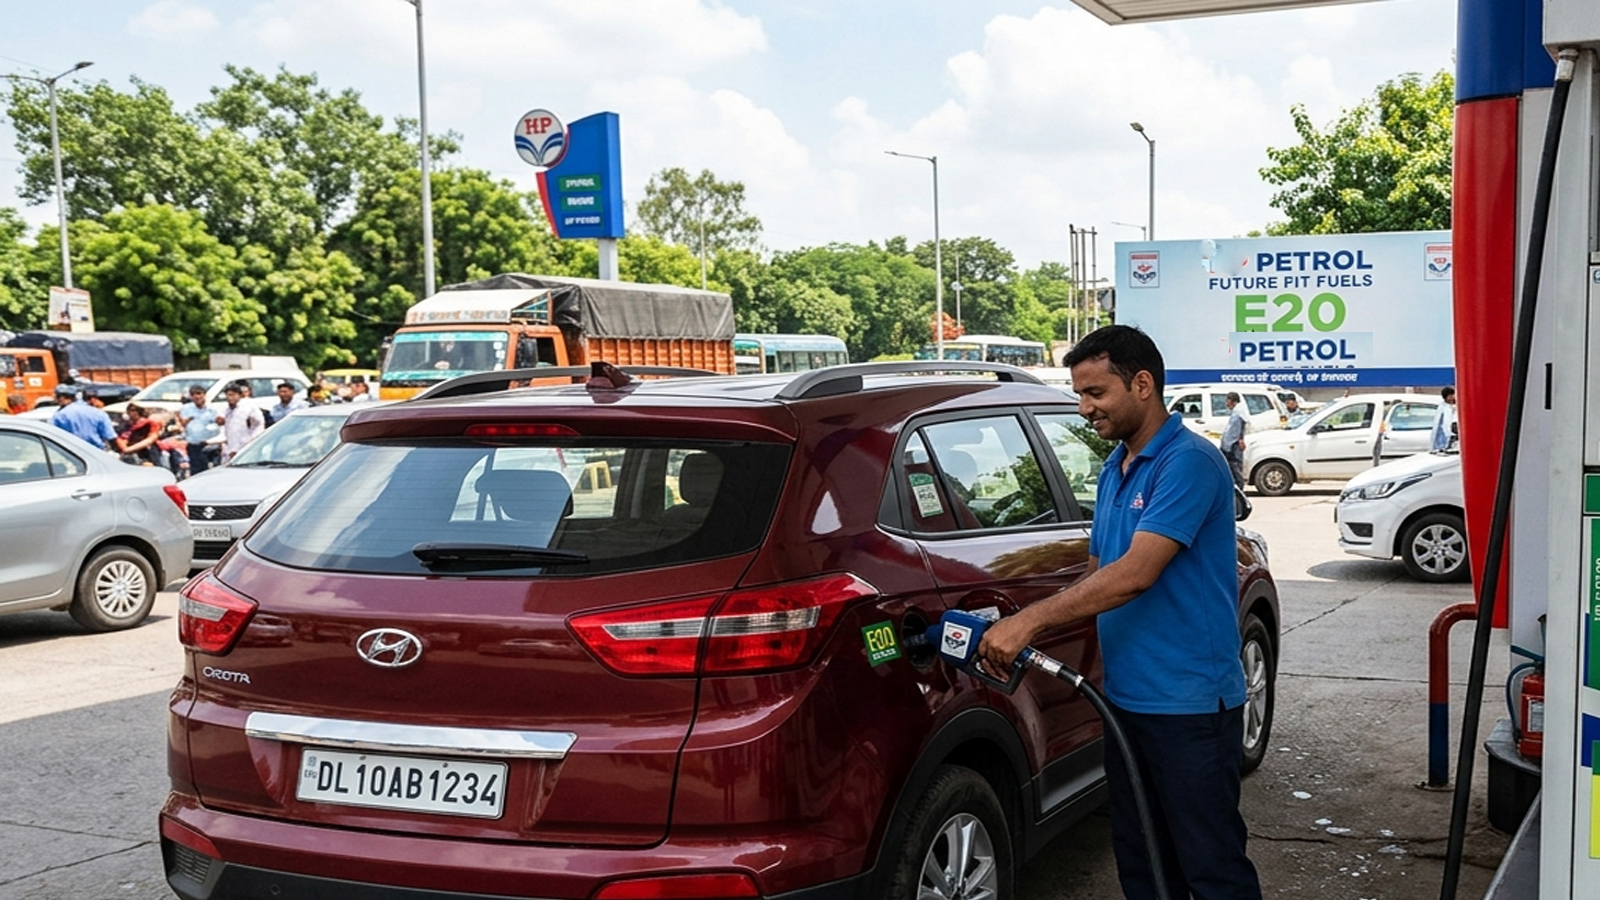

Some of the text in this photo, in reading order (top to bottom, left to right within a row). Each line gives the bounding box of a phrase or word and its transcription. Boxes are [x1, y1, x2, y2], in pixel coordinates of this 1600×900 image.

[524, 117, 552, 135] HP
[1257, 250, 1373, 272] PETROL
[1209, 276, 1278, 290] FUTURE
[1317, 274, 1373, 288] FUELS
[1235, 292, 1346, 332] E20
[1240, 339, 1356, 362] PETROL
